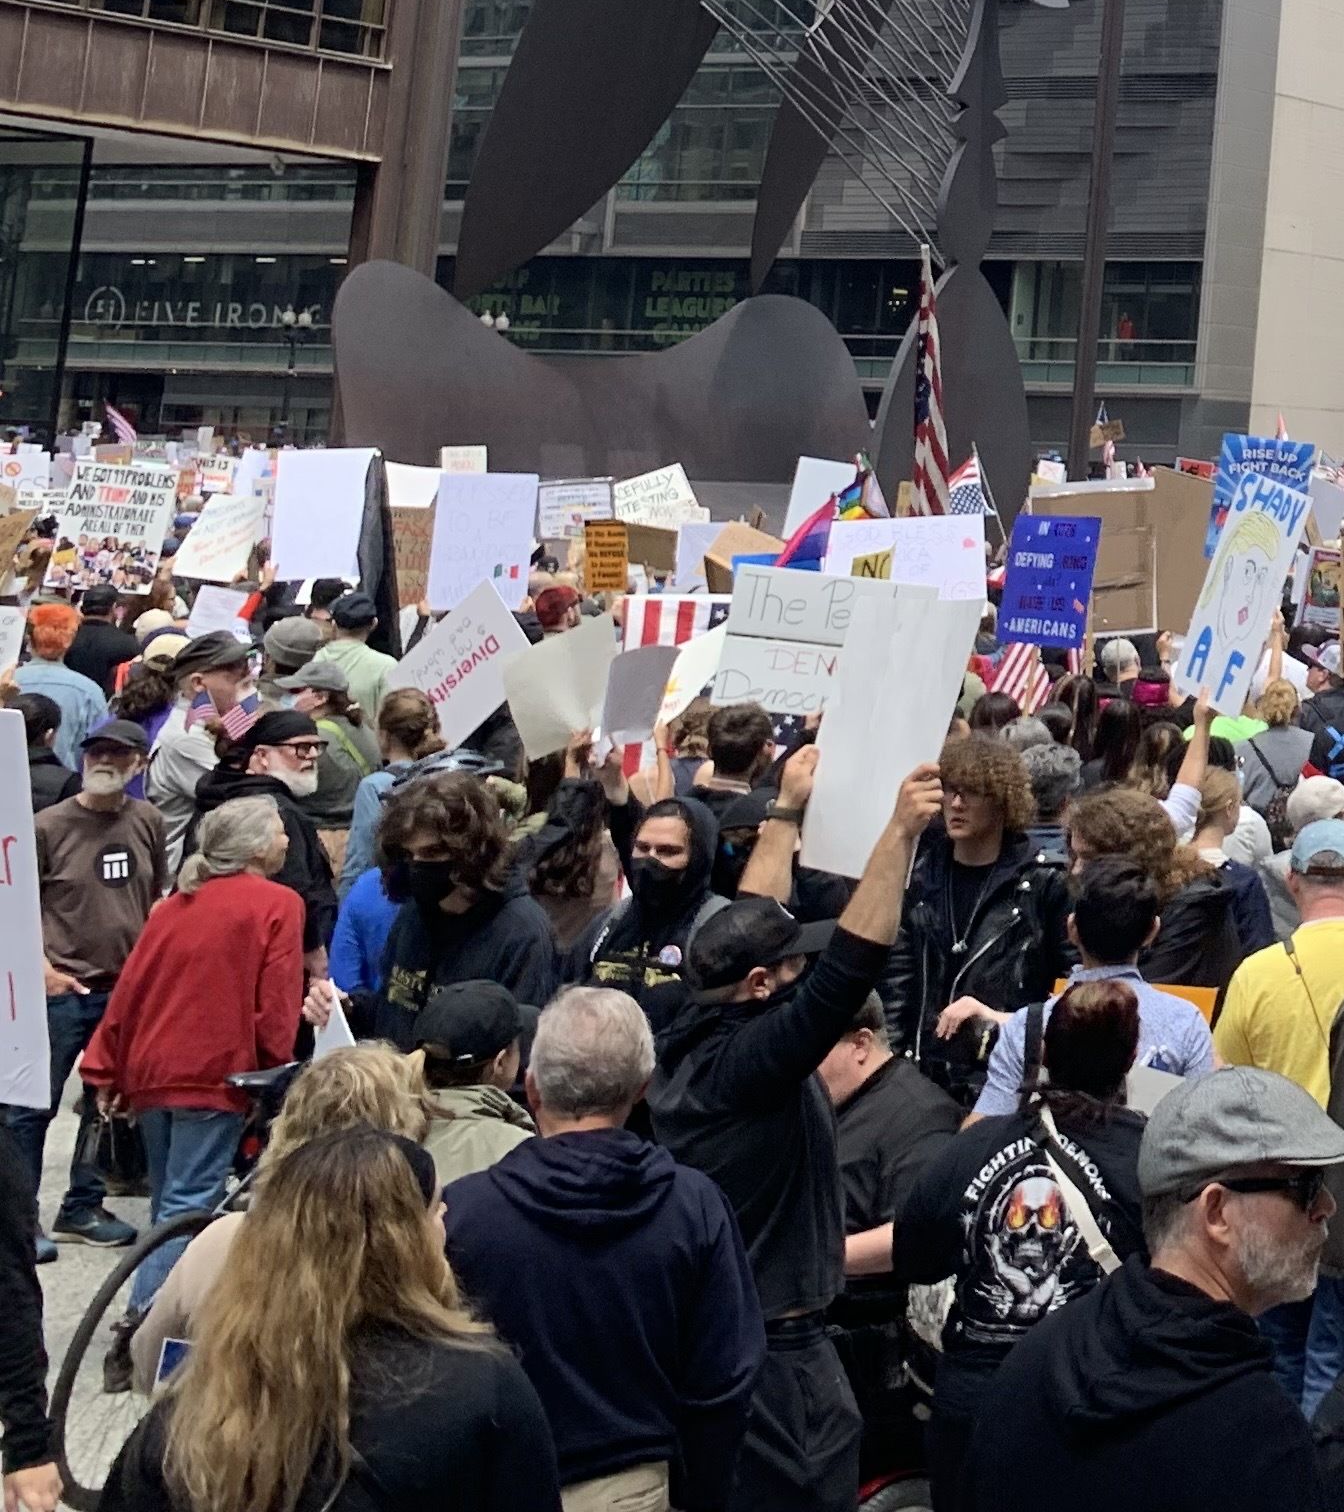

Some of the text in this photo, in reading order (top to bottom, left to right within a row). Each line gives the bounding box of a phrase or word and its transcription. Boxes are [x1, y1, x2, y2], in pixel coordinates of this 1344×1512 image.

[652, 272, 735, 291] PARTIES
[136, 301, 293, 328] FIVE IRON
[521, 295, 560, 315] BAR
[646, 297, 736, 317] LEAGUES
[1243, 449, 1298, 462] RISE UP
[77, 466, 176, 489] WE GOT 99 PROBLEMS
[1228, 462, 1306, 481] FIGHT BACK
[70, 484, 166, 506] AND AND HIS
[1236, 473, 1306, 537] SHADY
[100, 519, 111, 534] ALL
[125, 523, 145, 537] THEM
[1039, 521, 1051, 536] IN
[1015, 552, 1054, 568] DEFYING
[744, 573, 855, 629] The Pe
[1009, 617, 1077, 639] AMERICANS
[1188, 626, 1211, 683] A
[427, 634, 500, 706] Diversity
[1215, 649, 1246, 703] F
[716, 669, 829, 712] Democr
